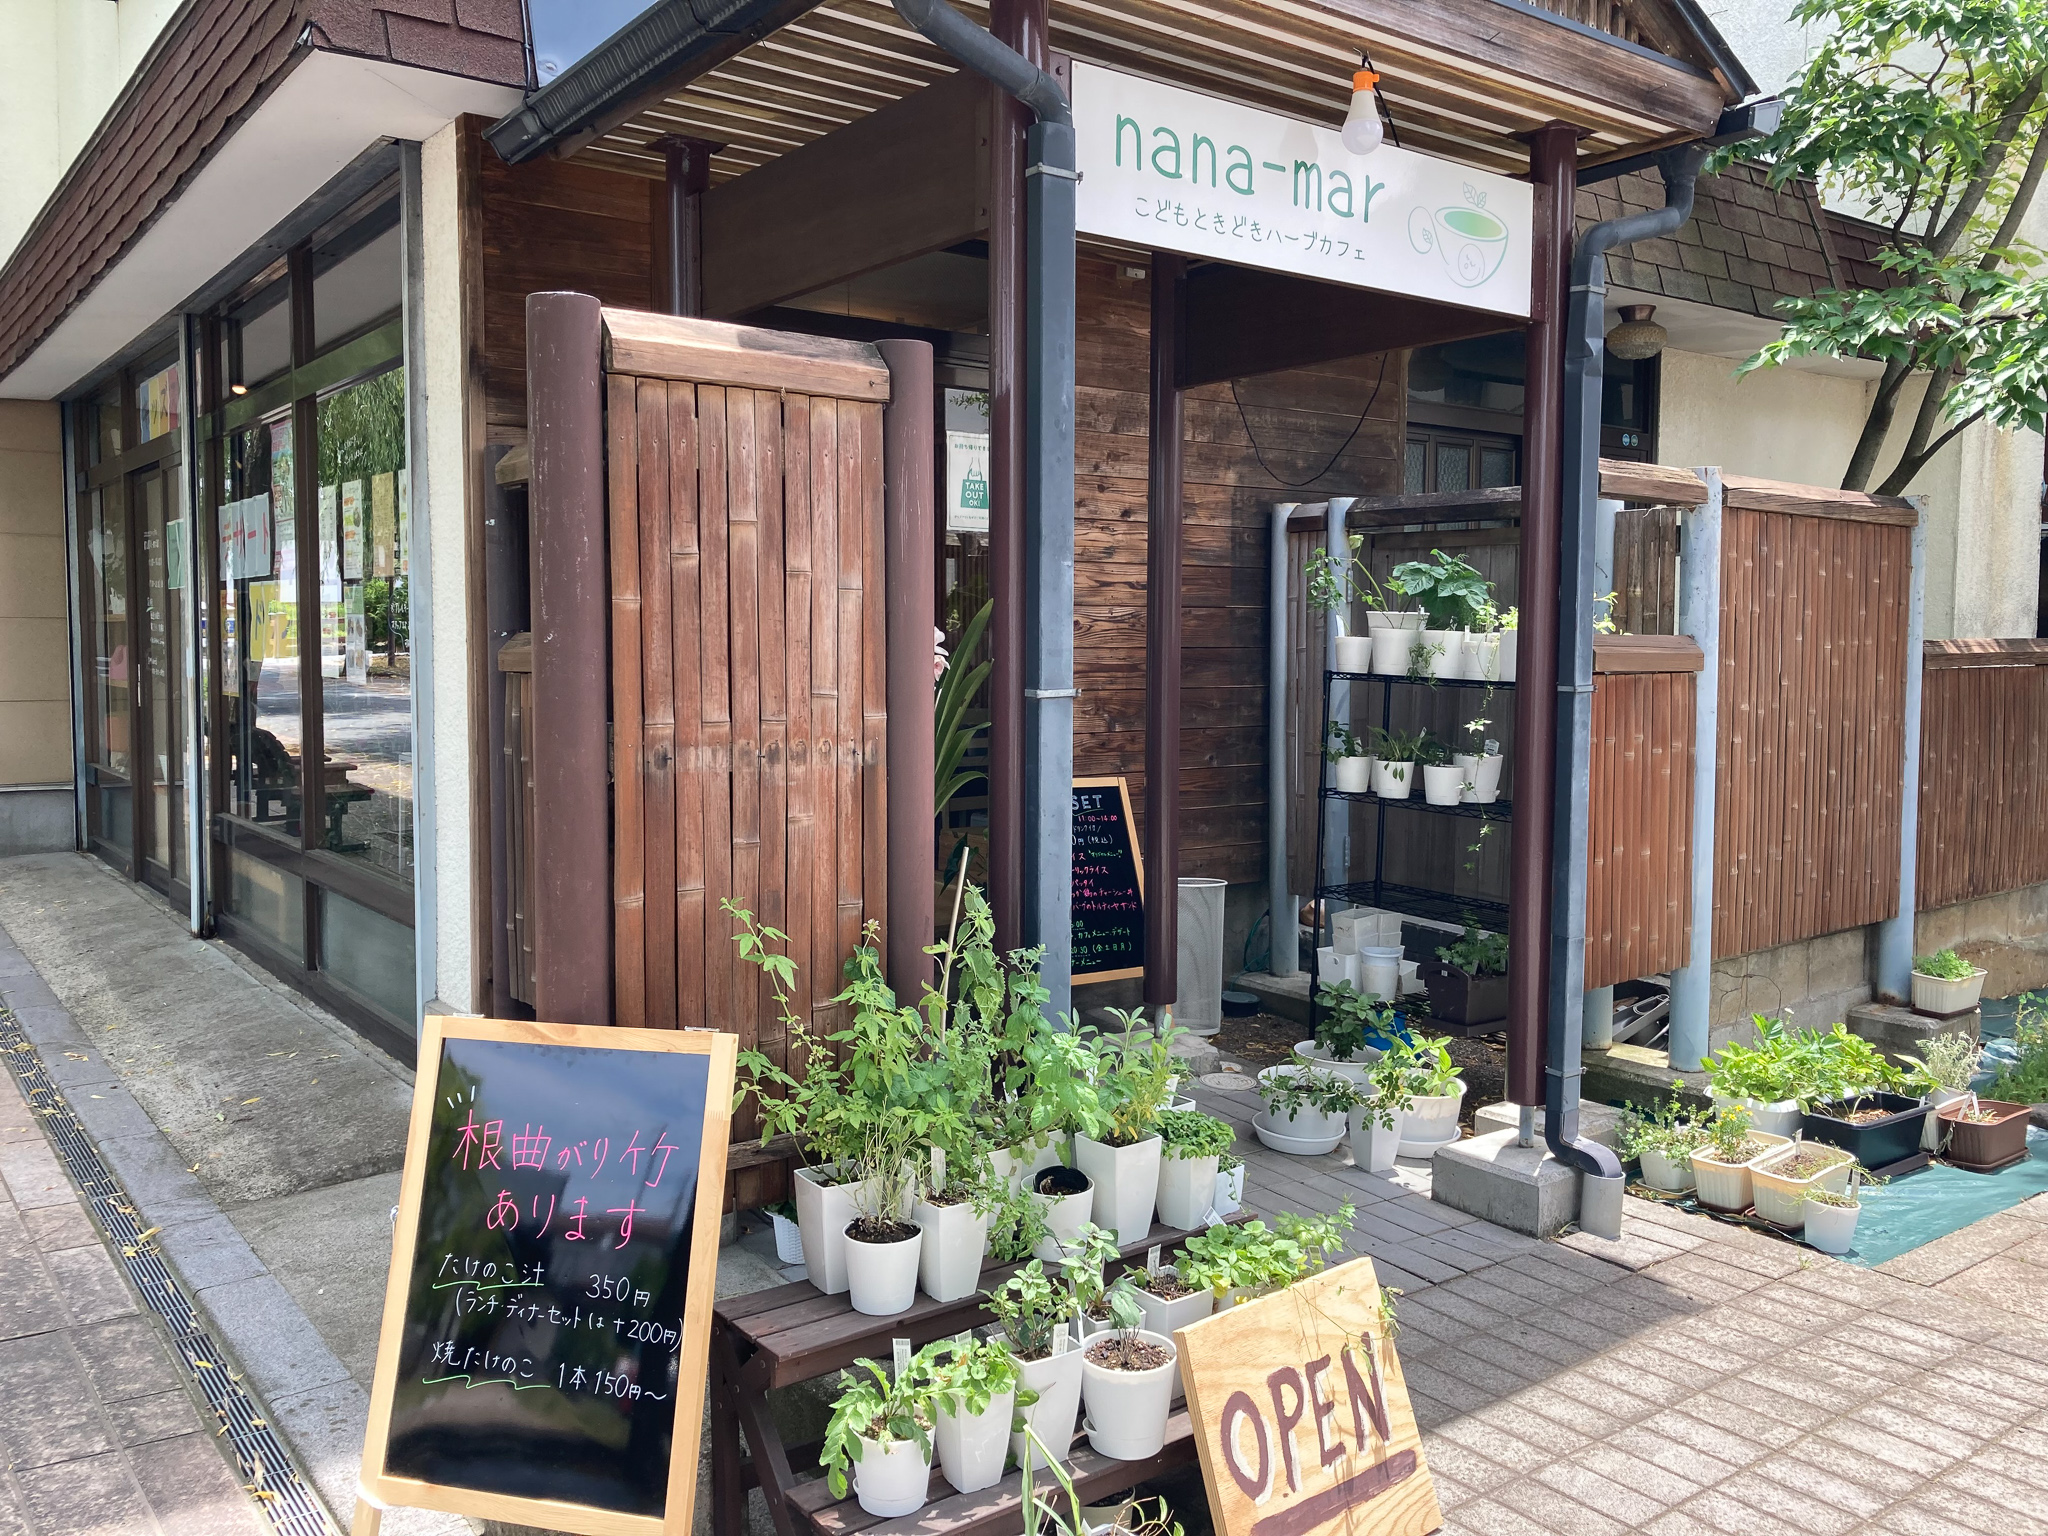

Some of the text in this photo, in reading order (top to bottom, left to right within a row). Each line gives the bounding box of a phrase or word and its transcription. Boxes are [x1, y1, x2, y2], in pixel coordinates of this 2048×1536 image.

[1115, 113, 1386, 223] nana-mar
[1134, 196, 1366, 262] こどもときどきハーブカフェ
[965, 482, 984, 490] TAKE
[965, 491, 984, 500] OUT
[1072, 794, 1102, 810] SET
[452, 1108, 680, 1188] 根曲がり竹
[486, 1189, 647, 1250] あります
[437, 1252, 652, 1308] たけのこ汁 350円
[430, 1340, 535, 1379] 焼たけのこ
[1220, 1331, 1393, 1507] OPEN
